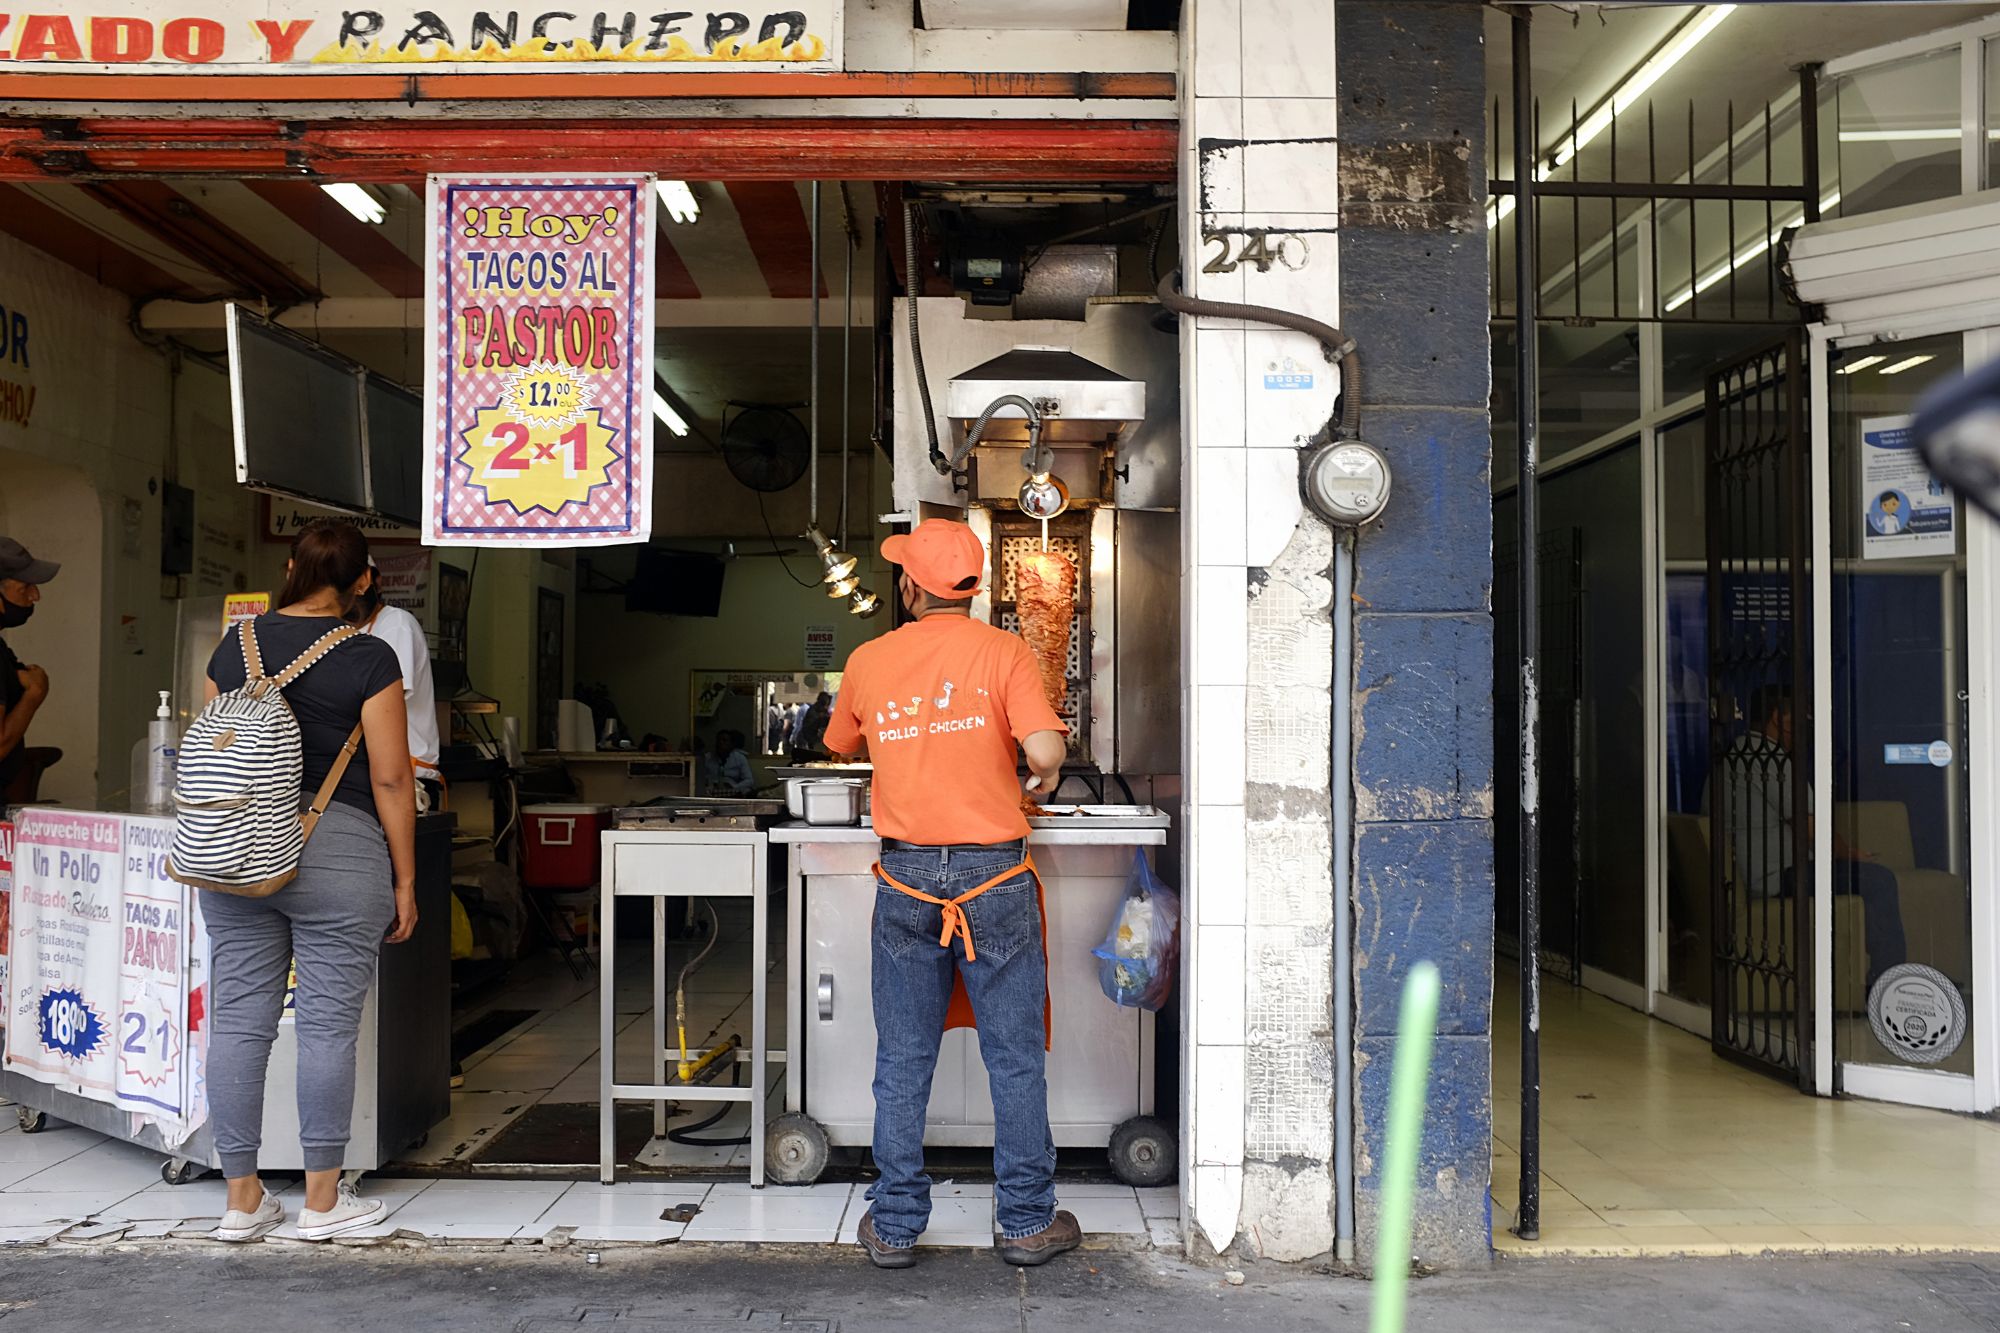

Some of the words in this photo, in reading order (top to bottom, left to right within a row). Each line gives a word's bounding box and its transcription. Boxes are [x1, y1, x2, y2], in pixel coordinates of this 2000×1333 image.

[0, 14, 225, 63] ADO
[255, 20, 314, 63] Y
[467, 251, 567, 290] TACOS
[578, 251, 617, 291] AL
[462, 304, 620, 369] PASTOR
[807, 633, 833, 643] AVISO
[879, 726, 919, 743] POLLO
[929, 715, 985, 734] CHICKEN
[20, 816, 91, 841] Aproveche
[33, 848, 49, 877] Un
[60, 850, 100, 884] Pollo
[128, 856, 143, 873] DE
[1906, 1022, 1925, 1032] 2020
